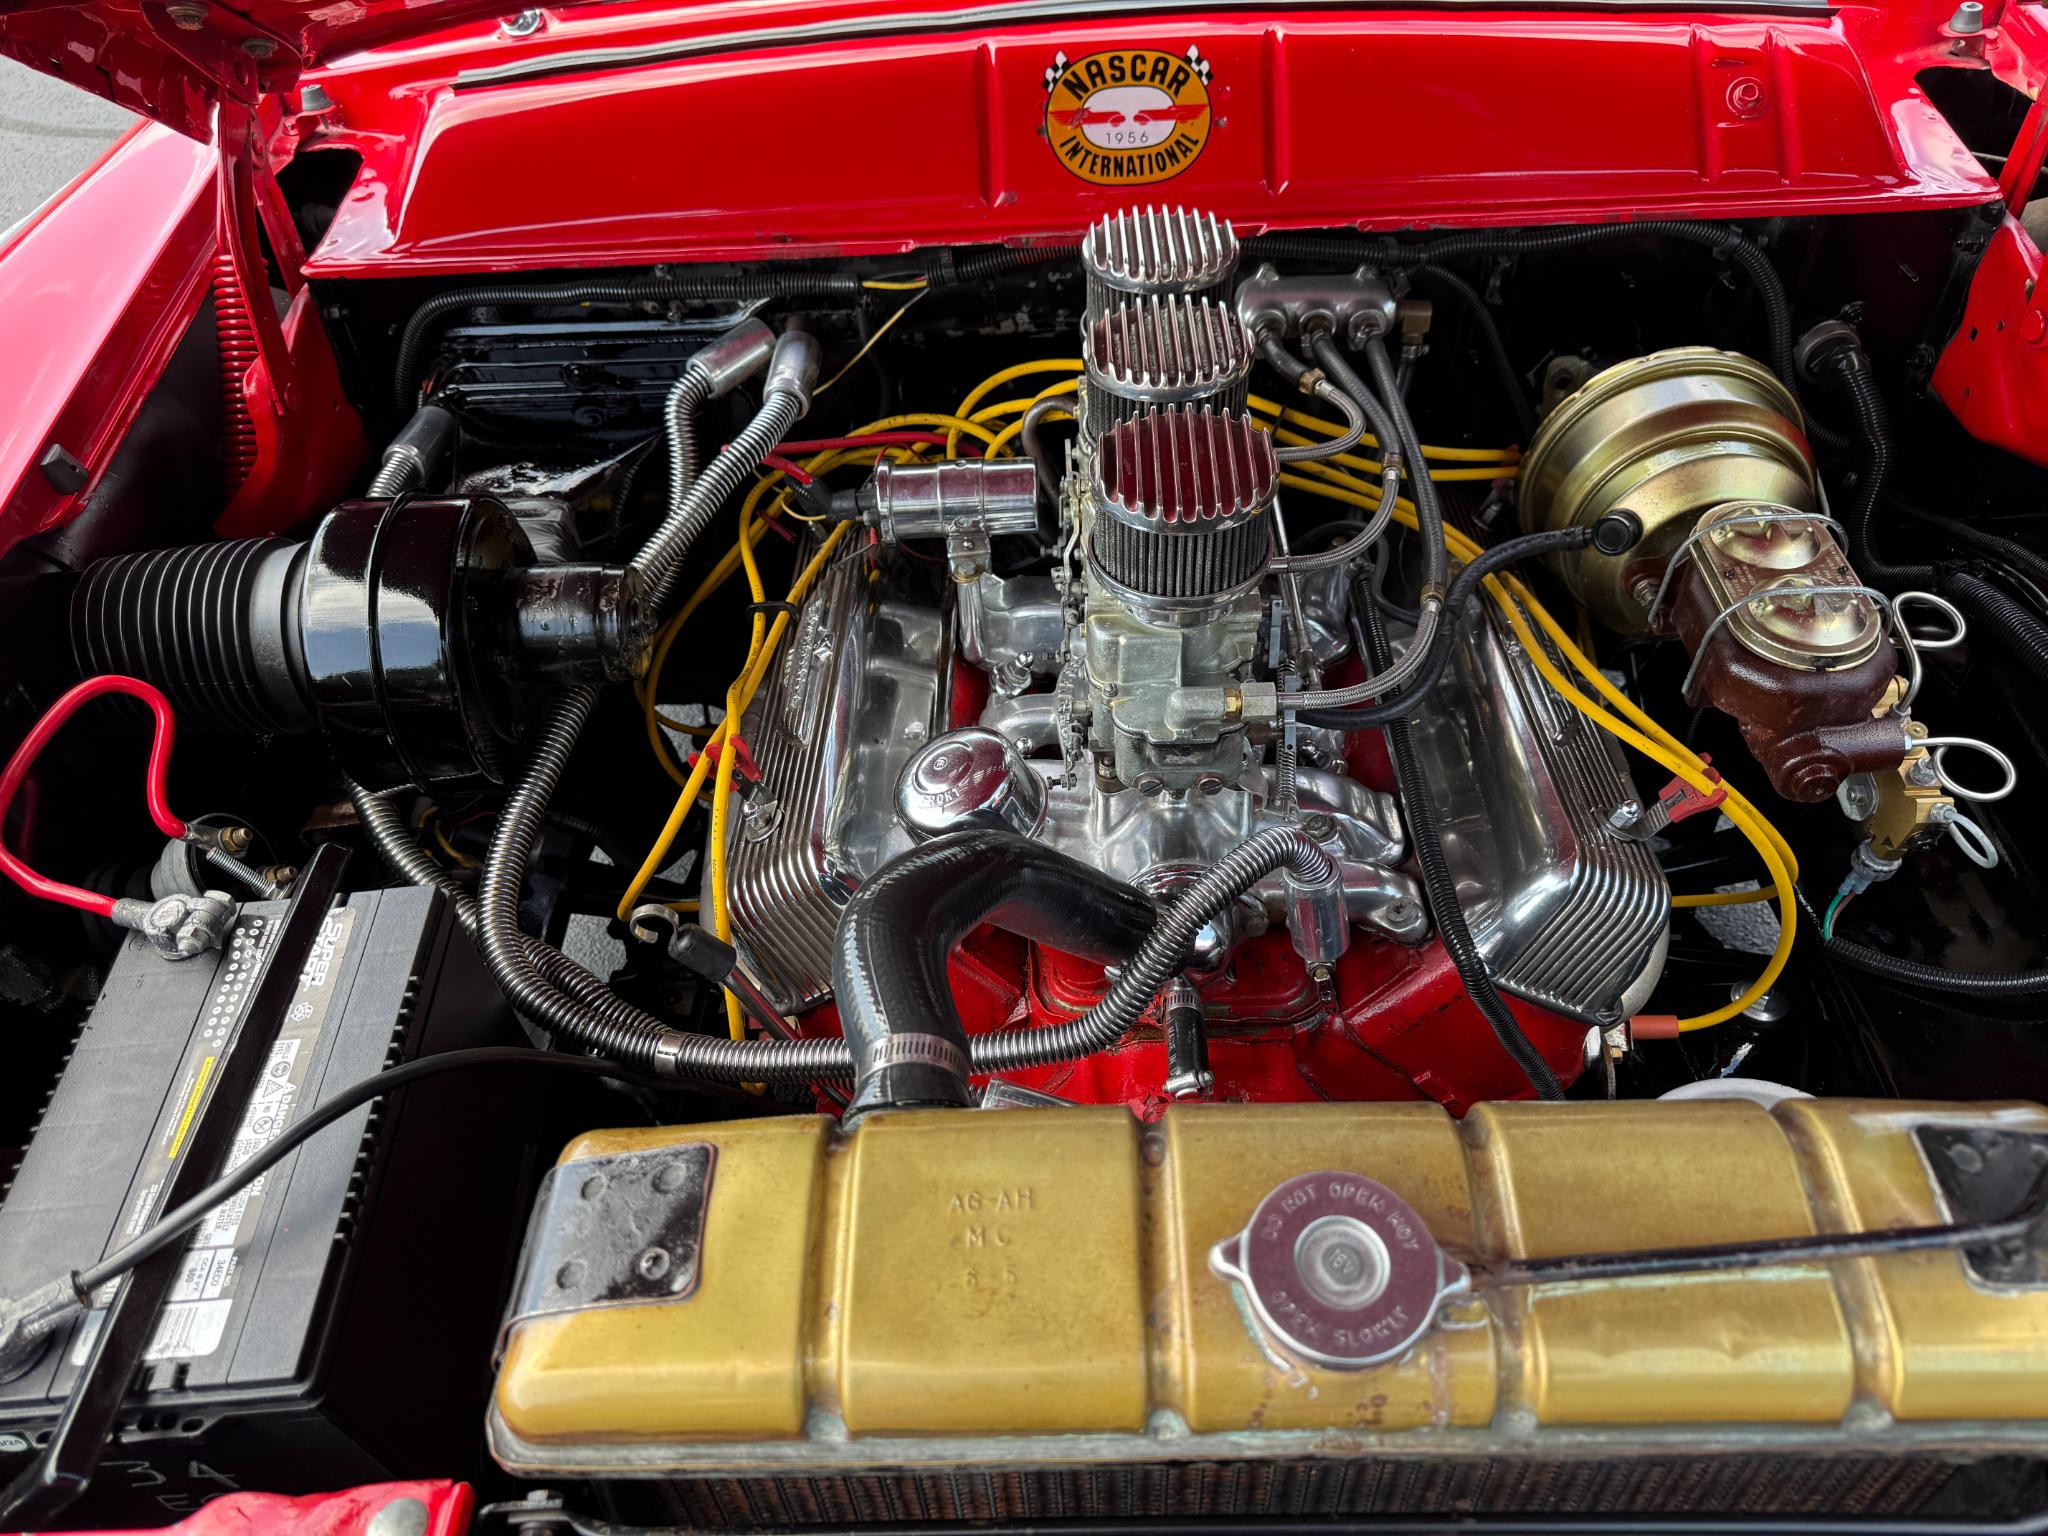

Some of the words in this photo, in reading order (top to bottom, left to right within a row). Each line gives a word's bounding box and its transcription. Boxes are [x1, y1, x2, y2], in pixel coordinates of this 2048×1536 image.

[1061, 54, 1191, 101] NASCAR
[1059, 133, 1199, 178] INTERNATIONAL
[1105, 132, 1149, 145] 1956
[312, 923, 343, 985] SUPER
[268, 1094, 292, 1139] DANGE
[1261, 1214, 1284, 1242] DO
[1281, 1183, 1317, 1213] NOT
[1328, 1181, 1385, 1212] OPEN
[1386, 1211, 1421, 1250] HOT
[1271, 1290, 1321, 1339] OPEN
[1333, 1304, 1410, 1348] SLOWLY
